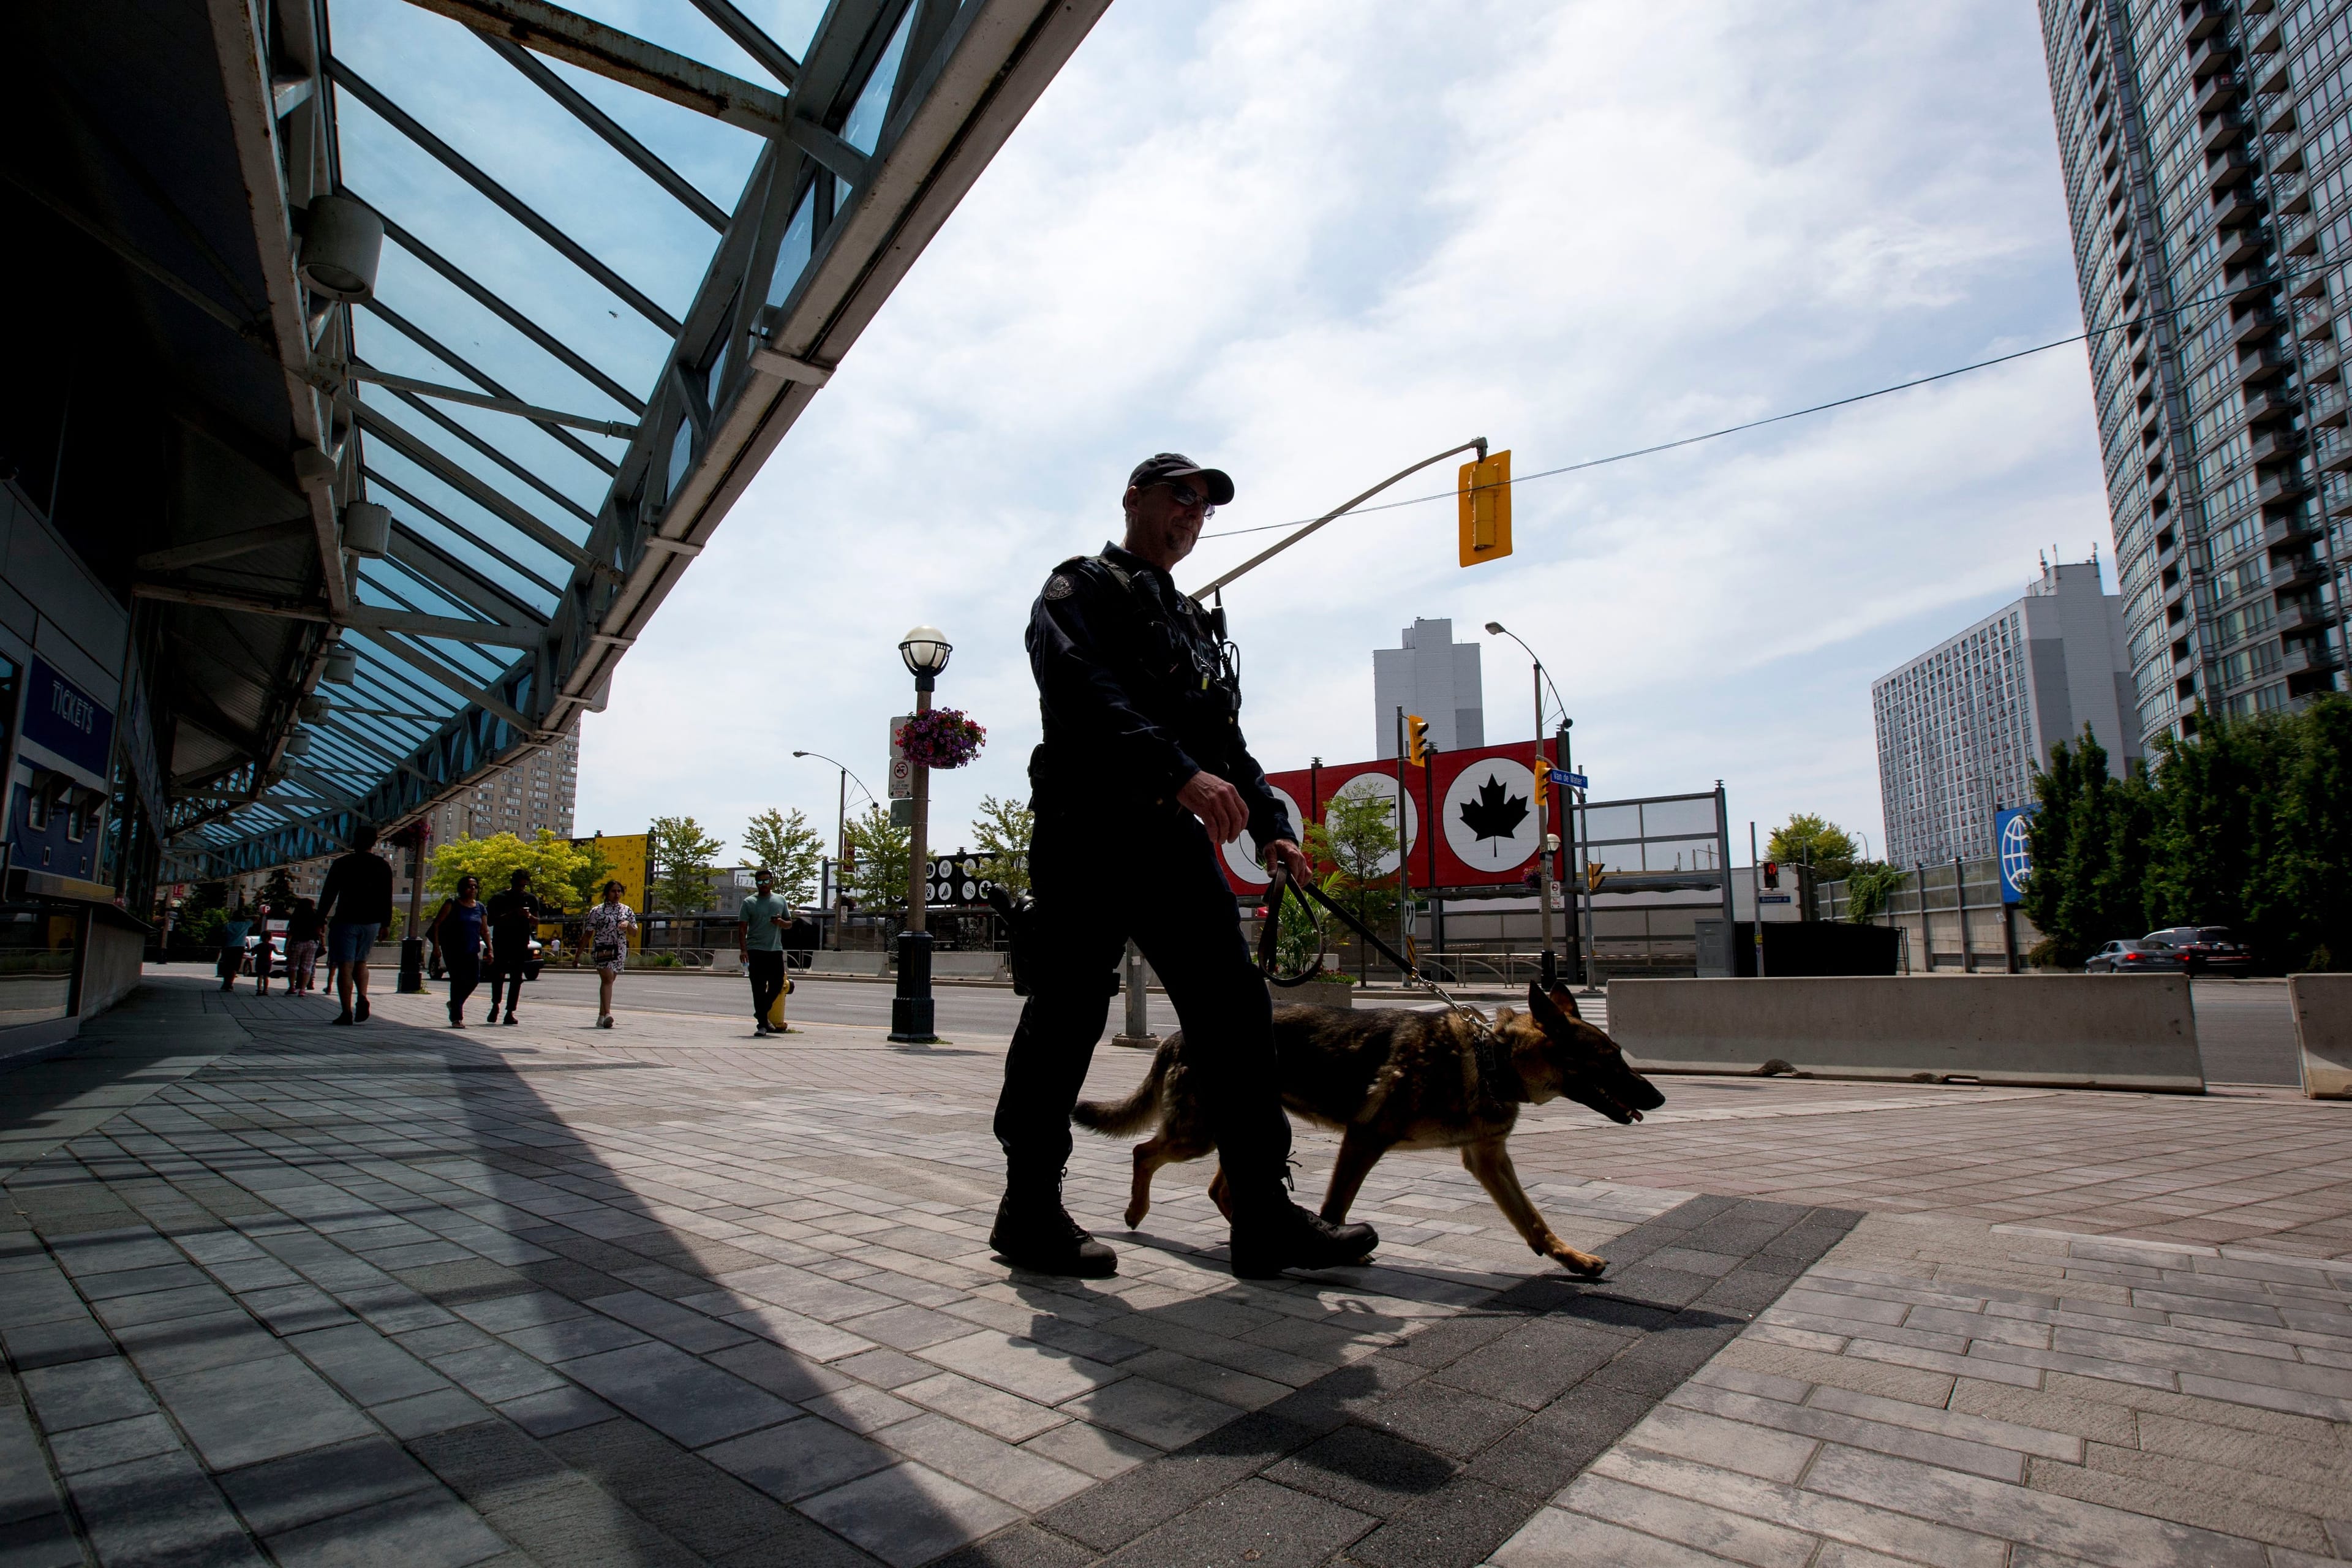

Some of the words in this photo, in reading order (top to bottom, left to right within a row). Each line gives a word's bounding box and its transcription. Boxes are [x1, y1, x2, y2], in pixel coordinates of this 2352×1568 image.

[51, 679, 95, 735] TICKETS
[1553, 771, 1562, 781] Van
[1563, 774, 1569, 782] de
[1570, 774, 1582, 785] Water
[1546, 865, 1553, 878] 40
